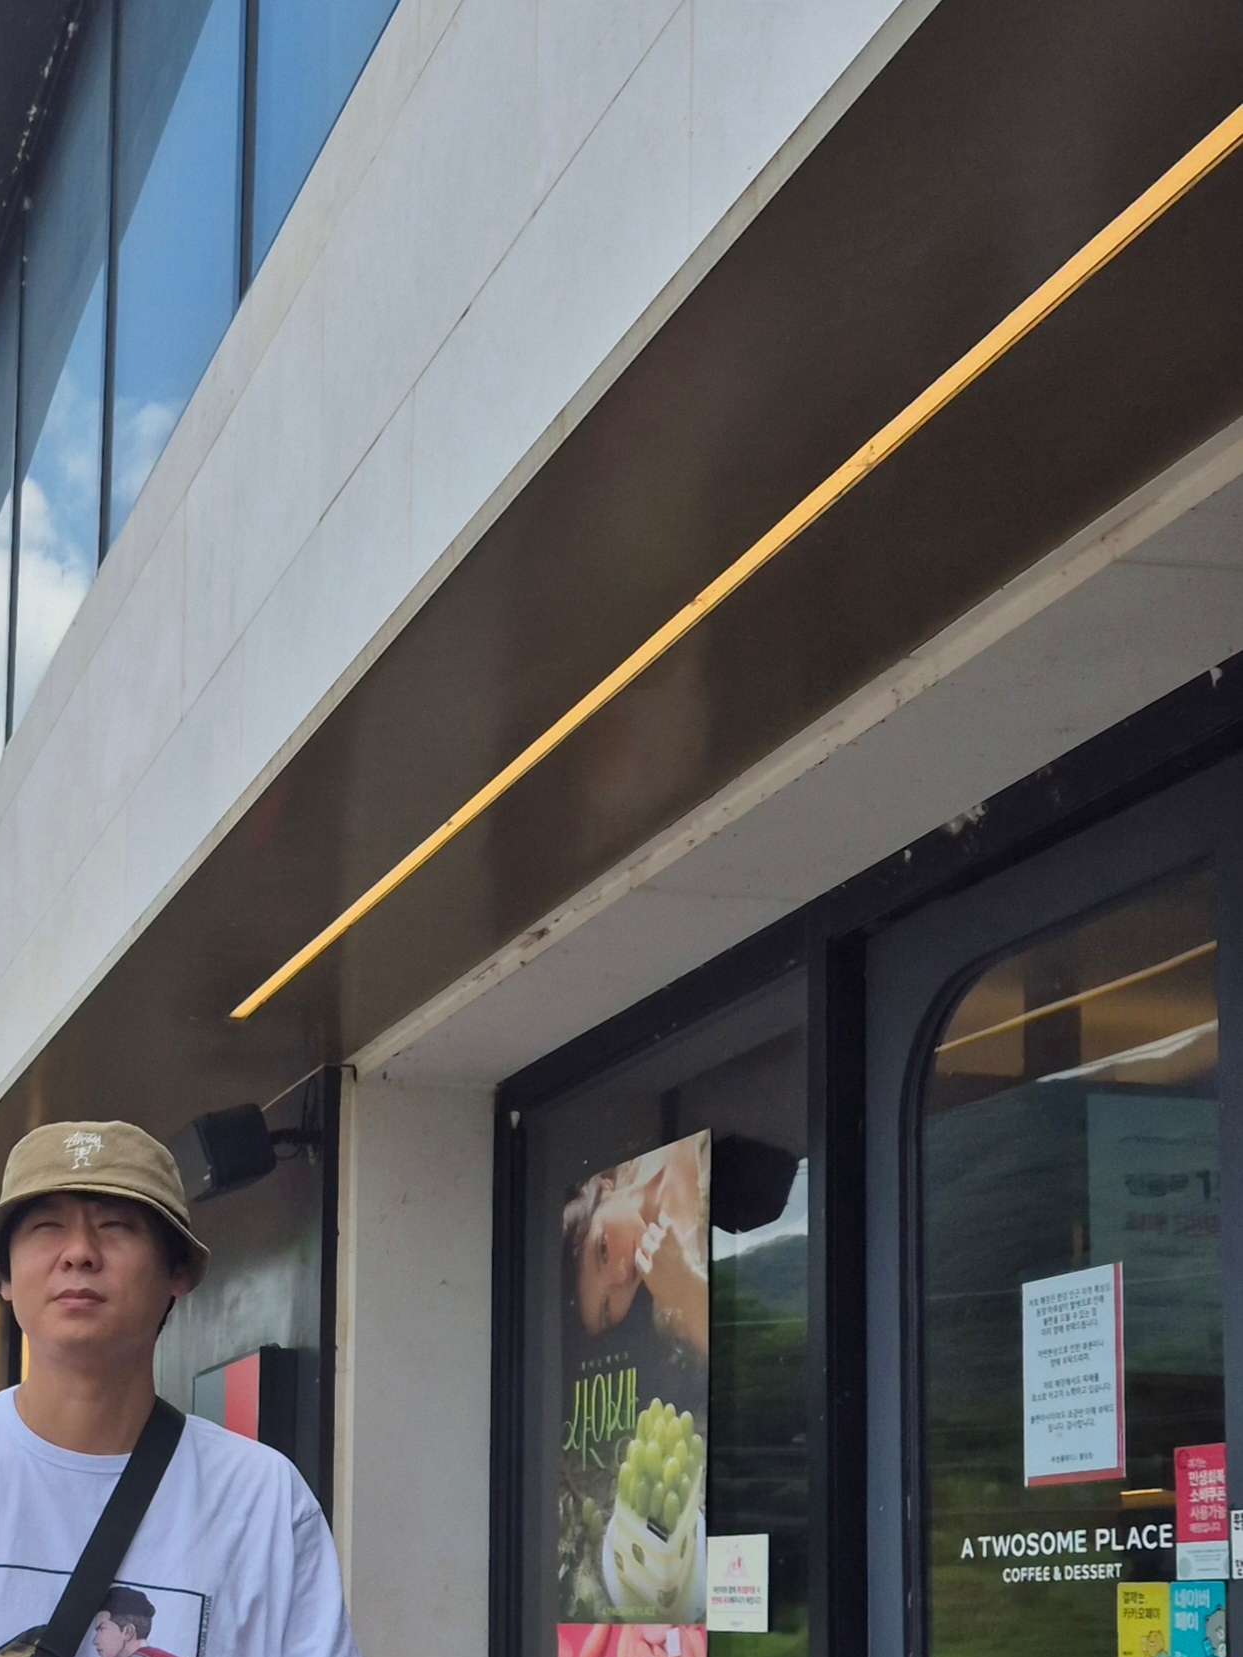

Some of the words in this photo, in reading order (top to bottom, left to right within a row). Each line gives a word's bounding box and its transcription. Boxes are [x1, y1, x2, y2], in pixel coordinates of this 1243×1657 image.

[1190, 1504, 1226, 1520] 사용가능
[960, 1537, 975, 1560] A
[978, 1529, 1088, 1558] TWOSOME
[1095, 1523, 1174, 1552] PLACE
[1002, 1565, 1050, 1583] COFFEE
[1052, 1565, 1062, 1581] &
[1064, 1563, 1123, 1581] DESSERT
[1174, 1588, 1211, 1609] 네이버
[1122, 1607, 1161, 1620] 카카오페이
[1174, 1611, 1199, 1632] 페이
